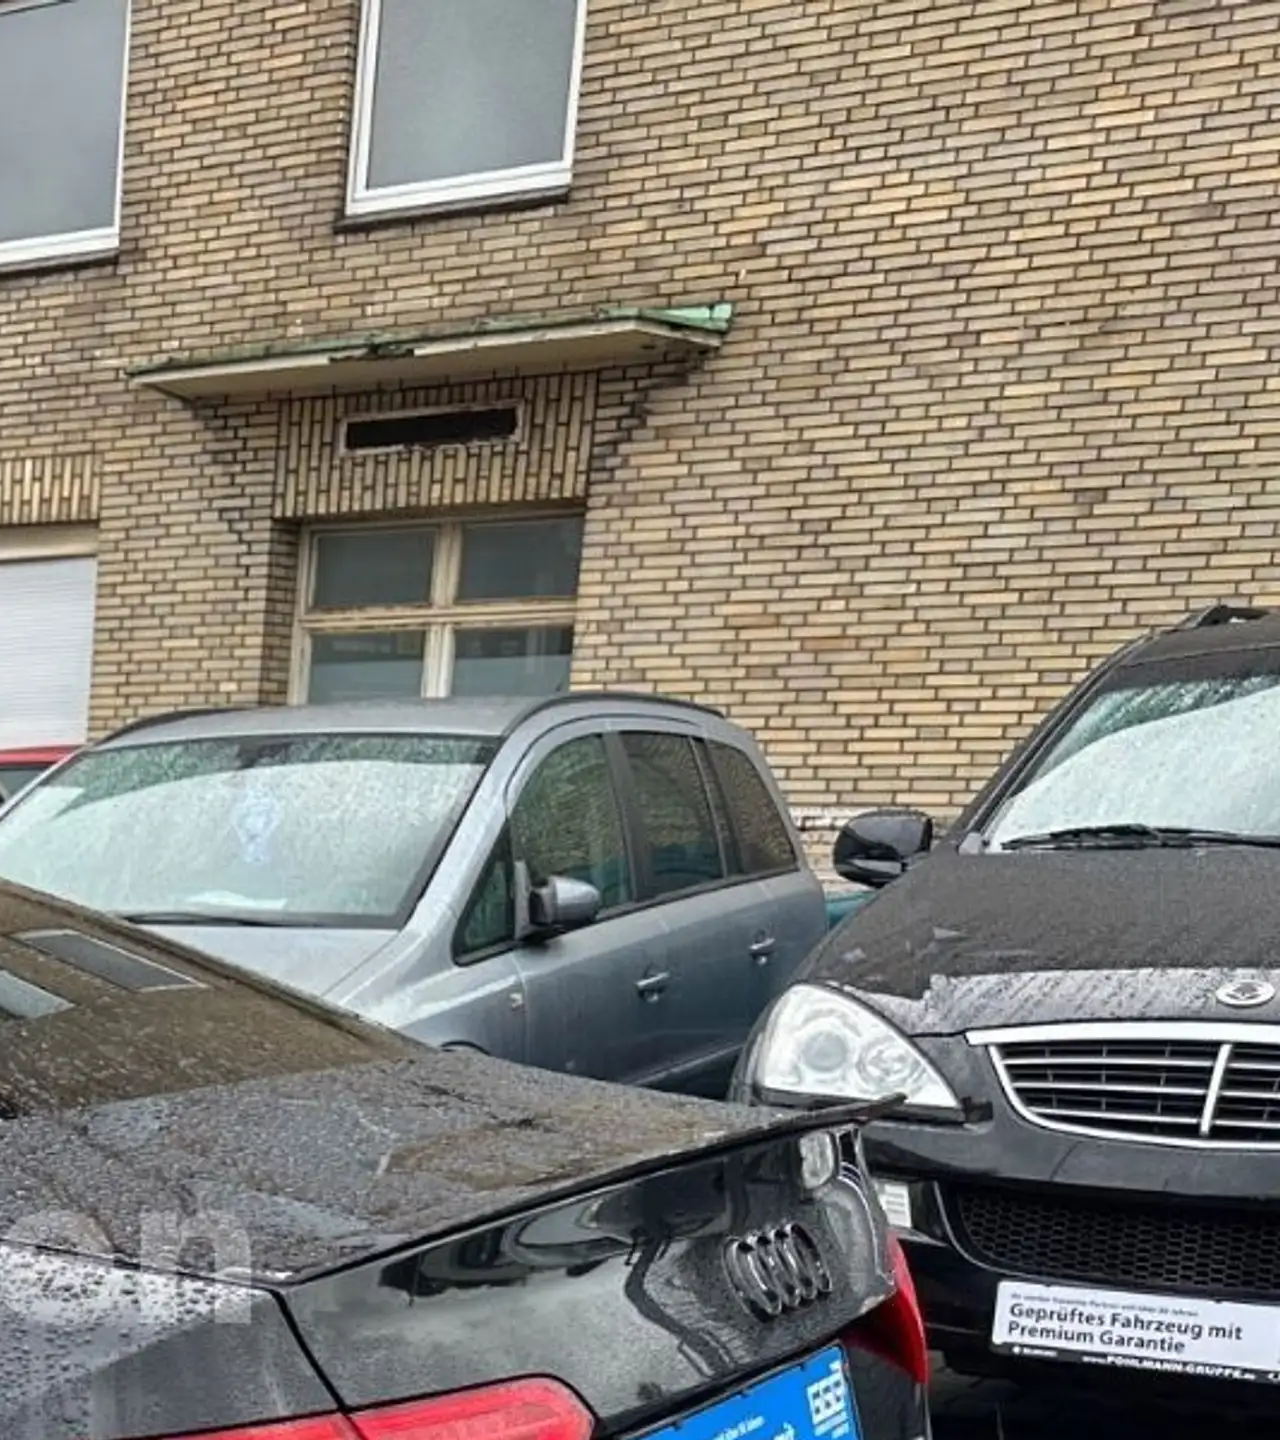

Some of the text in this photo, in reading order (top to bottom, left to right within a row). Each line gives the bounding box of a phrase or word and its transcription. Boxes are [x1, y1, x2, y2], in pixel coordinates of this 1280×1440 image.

[1008, 1321, 1186, 1353] Premium Garantie
[1010, 1302, 1243, 1341] Geprüftes Fahrzeug mit
